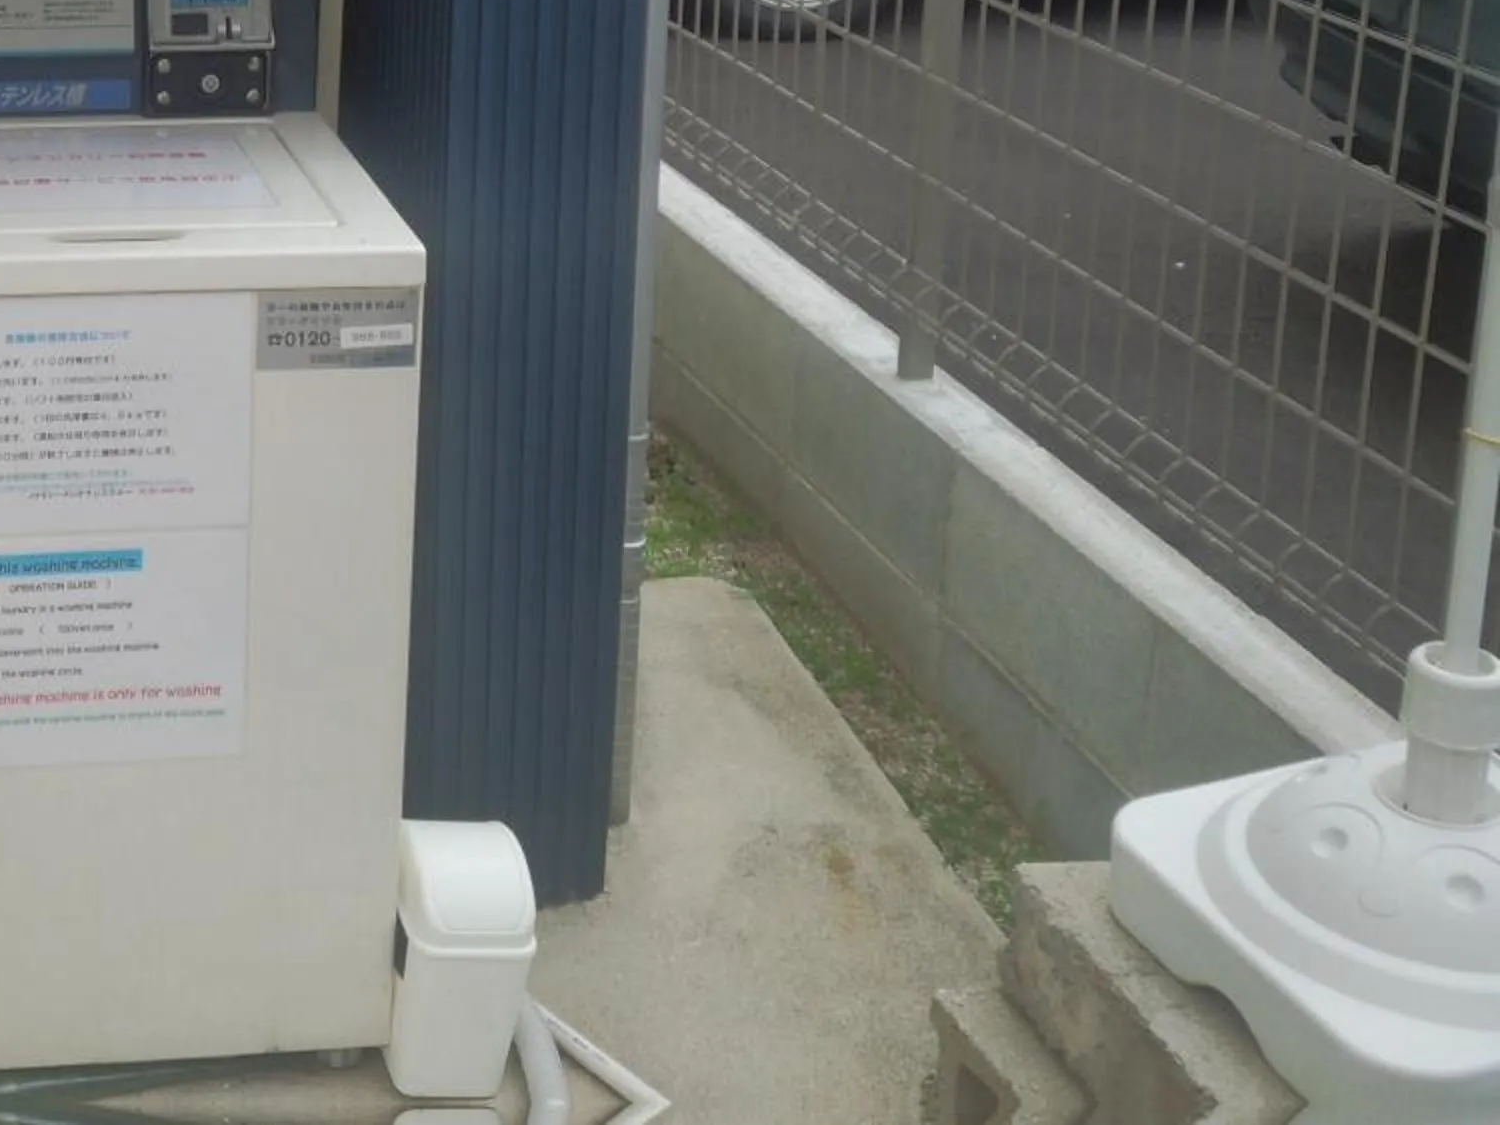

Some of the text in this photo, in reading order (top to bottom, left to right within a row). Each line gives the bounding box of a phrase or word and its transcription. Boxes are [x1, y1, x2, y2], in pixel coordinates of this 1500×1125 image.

[35, 690, 89, 705] machine
[93, 689, 104, 700] is
[108, 687, 136, 699] only
[141, 685, 162, 699] for
[166, 683, 221, 697] washing
